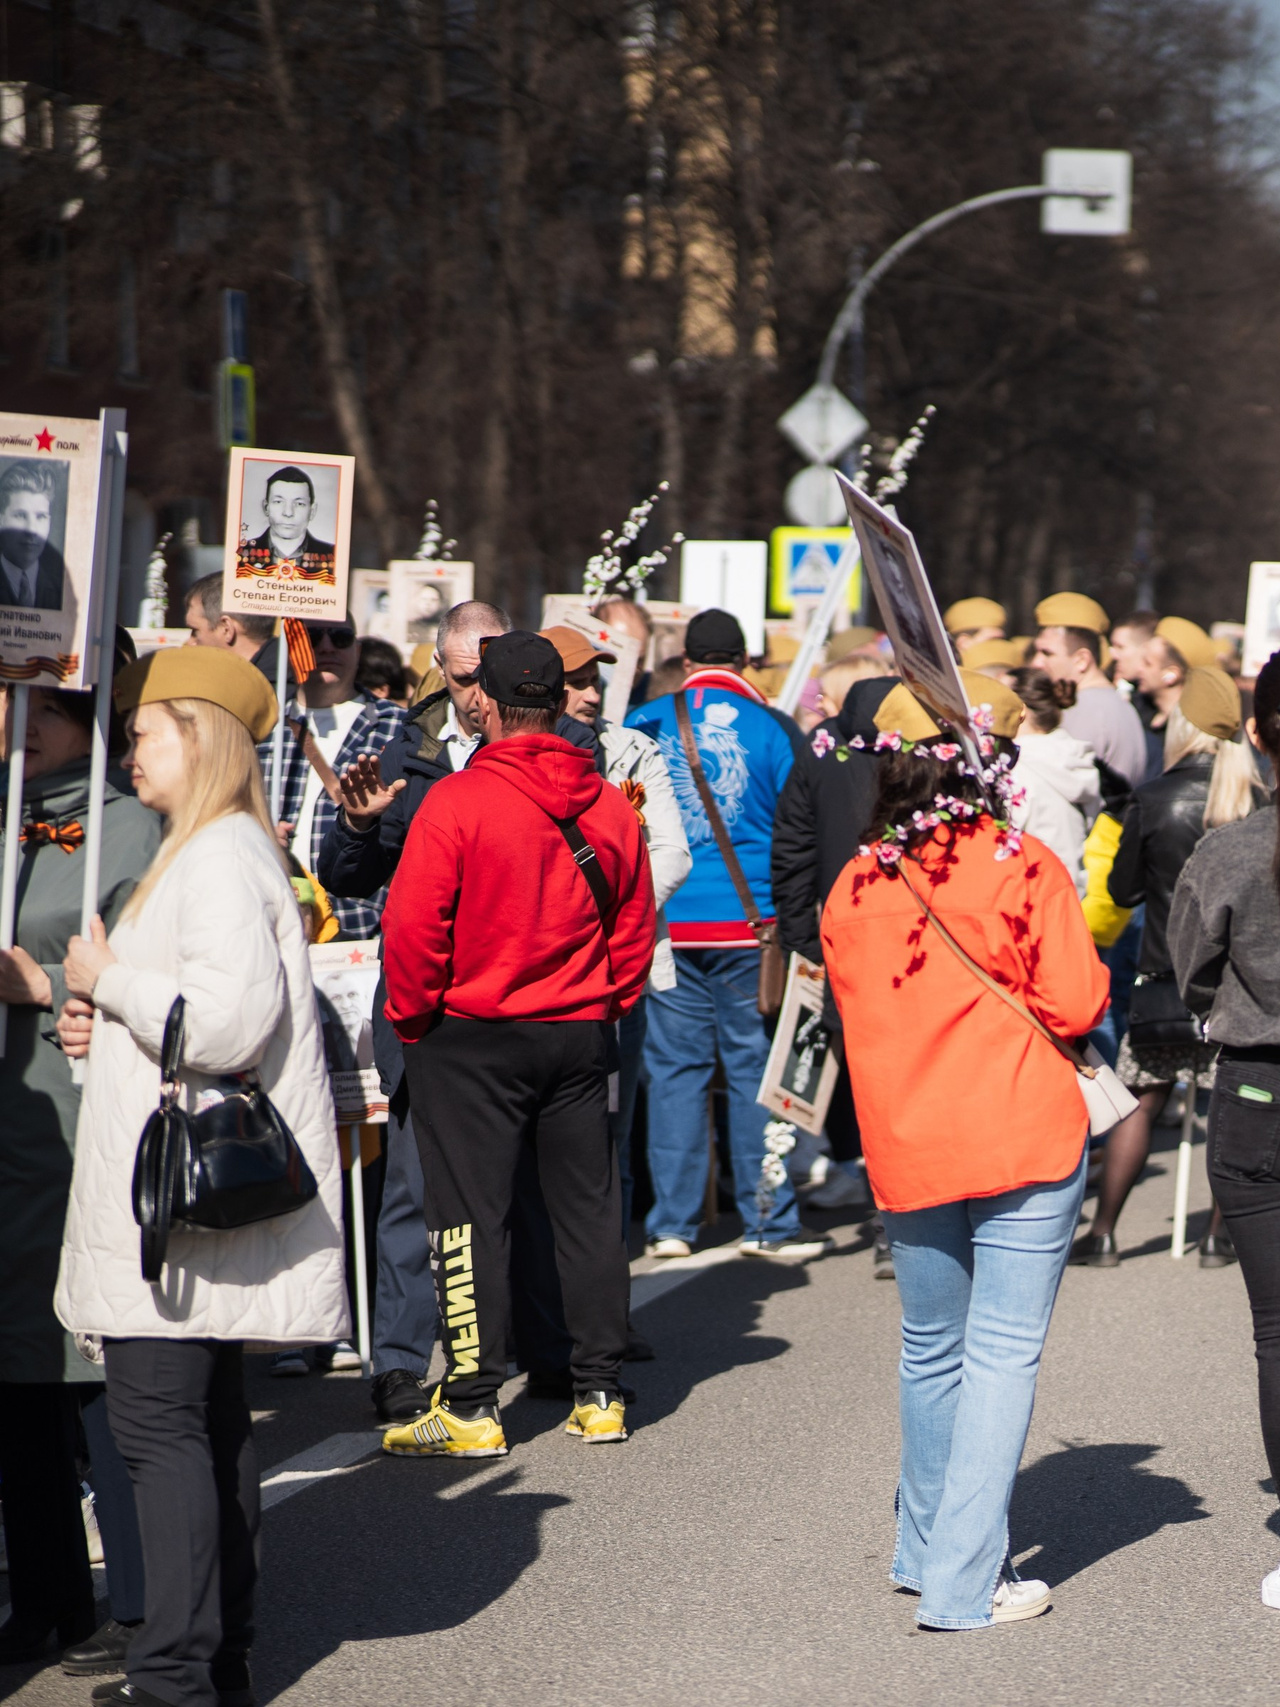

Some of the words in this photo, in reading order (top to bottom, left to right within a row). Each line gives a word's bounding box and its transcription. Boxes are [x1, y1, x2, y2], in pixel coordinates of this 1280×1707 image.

[256, 579, 314, 592] Стенькин
[233, 588, 275, 600] Степан
[279, 592, 337, 606] Егорович
[241, 600, 282, 612] Старший
[0, 610, 41, 622] гнатенко
[14, 627, 62, 641] Иванович
[336, 1084, 379, 1095] Дмитриев
